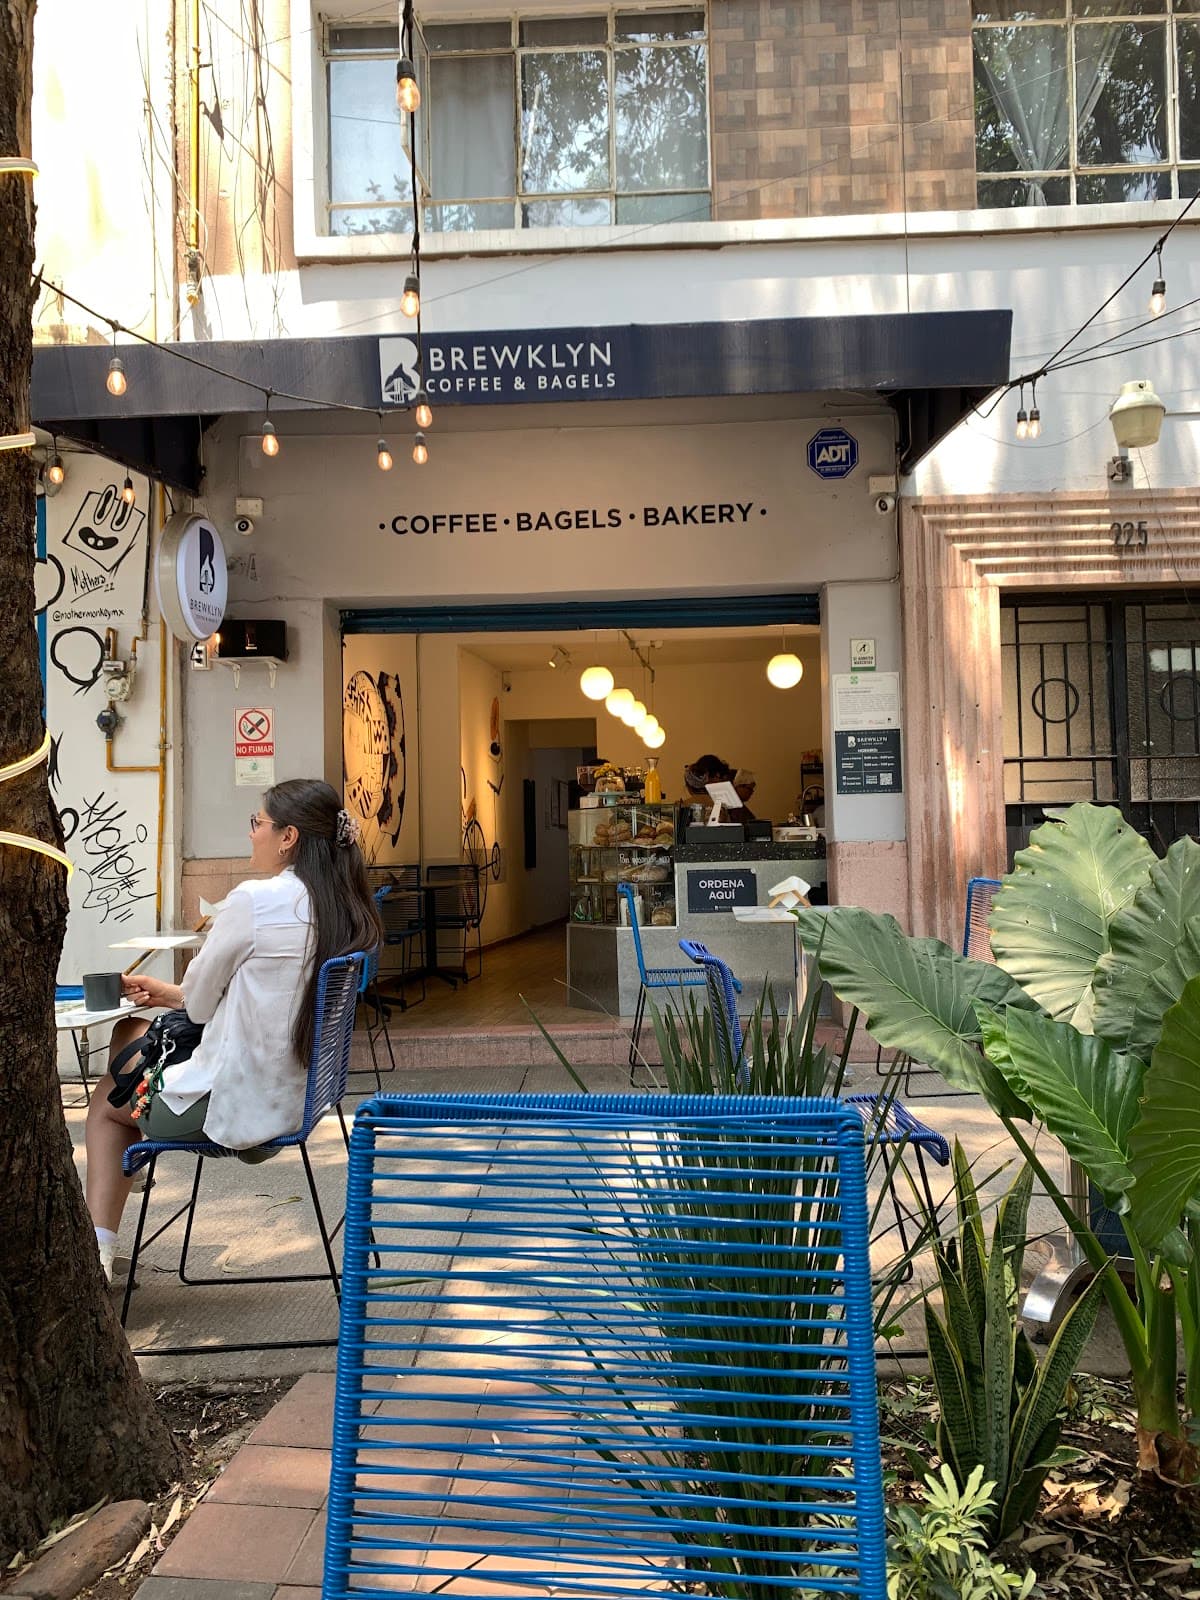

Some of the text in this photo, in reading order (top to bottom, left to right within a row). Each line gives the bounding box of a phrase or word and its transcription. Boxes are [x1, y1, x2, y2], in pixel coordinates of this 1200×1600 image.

[429, 342, 612, 372] BREWKLYN
[425, 373, 616, 393] COFFEE & BAGELS
[817, 444, 850, 464] ADT
[391, 502, 753, 535] COFFEE BAGELS BAKERY
[1110, 520, 1148, 550] 225
[190, 598, 223, 617] BREWKLYN
[236, 745, 273, 754] NO FUMAR
[698, 879, 745, 889] ORDENA
[708, 889, 736, 900] AQUÍ
